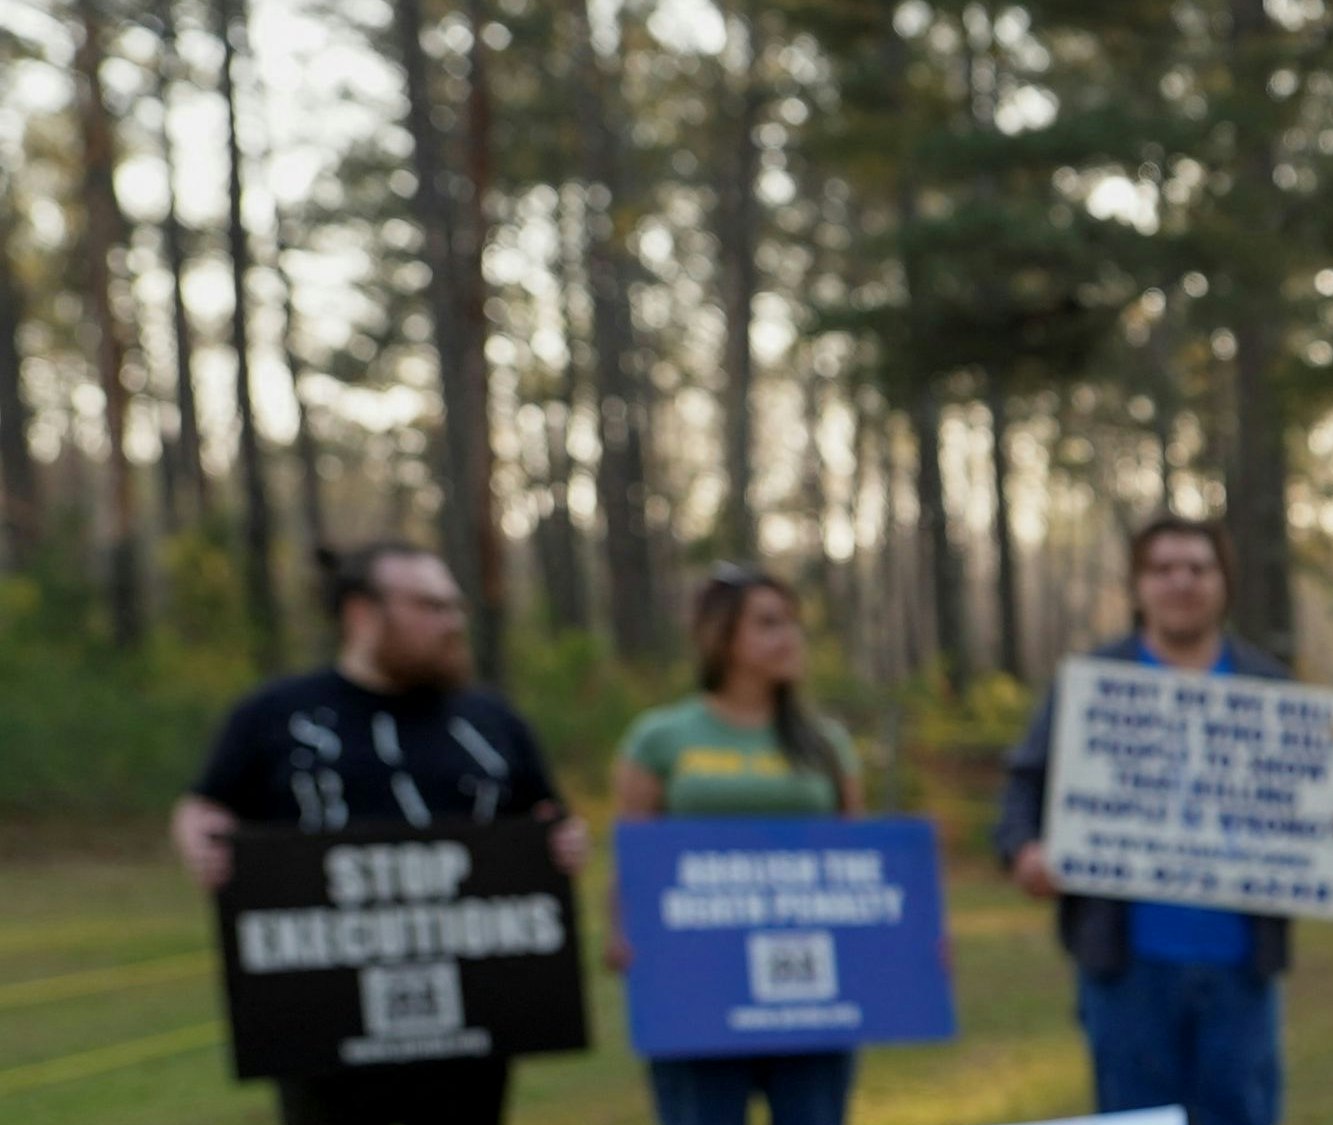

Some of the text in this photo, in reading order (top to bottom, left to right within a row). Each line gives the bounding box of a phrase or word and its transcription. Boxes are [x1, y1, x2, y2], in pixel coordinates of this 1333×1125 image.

[326, 843, 469, 908] STOP
[823, 850, 882, 884] THE
[237, 894, 564, 974] EXECUTIONS
